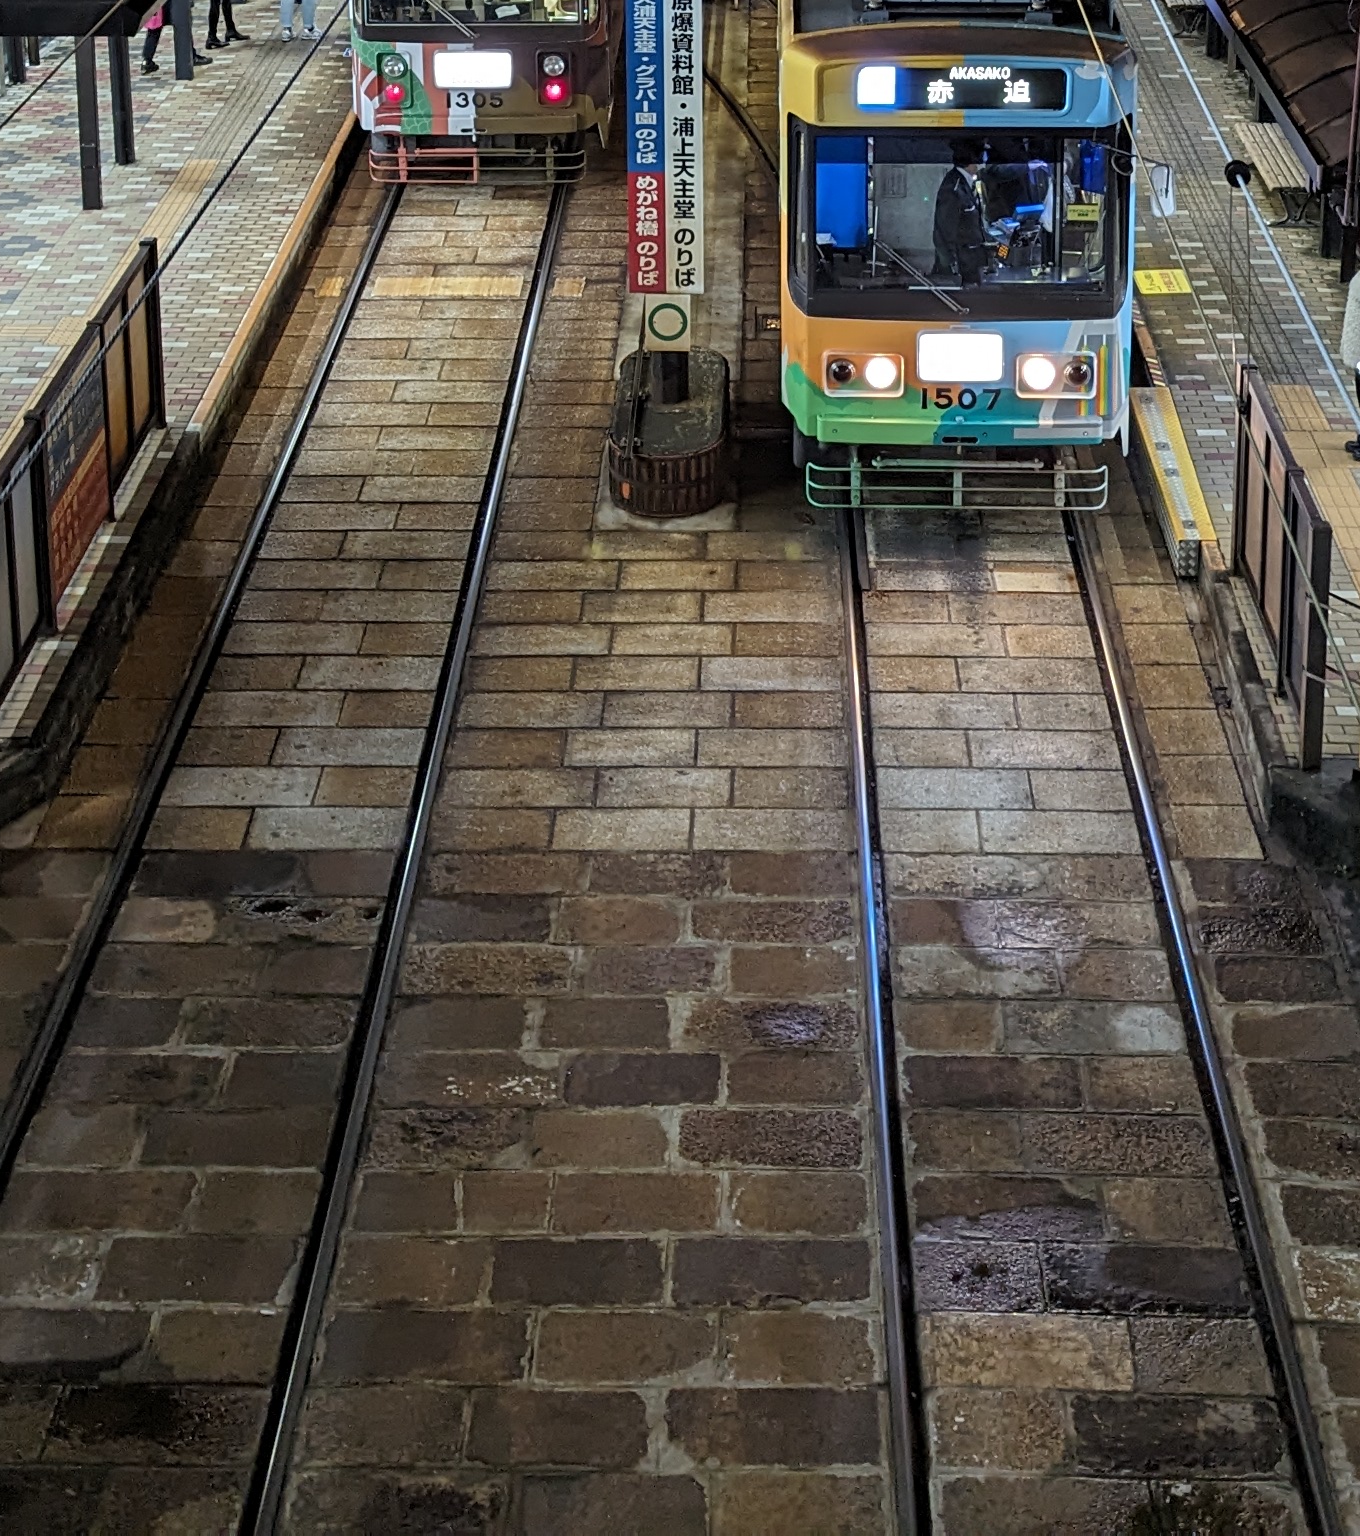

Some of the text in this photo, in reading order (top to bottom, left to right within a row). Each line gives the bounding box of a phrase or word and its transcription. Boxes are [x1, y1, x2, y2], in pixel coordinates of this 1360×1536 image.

[949, 66, 1011, 81] AKASAKO
[445, 91, 504, 110] 1305
[634, 127, 658, 164] のりば
[635, 175, 659, 286] めがね橋 のりば
[674, 227, 696, 288] のりば
[920, 387, 1003, 411] 1507
